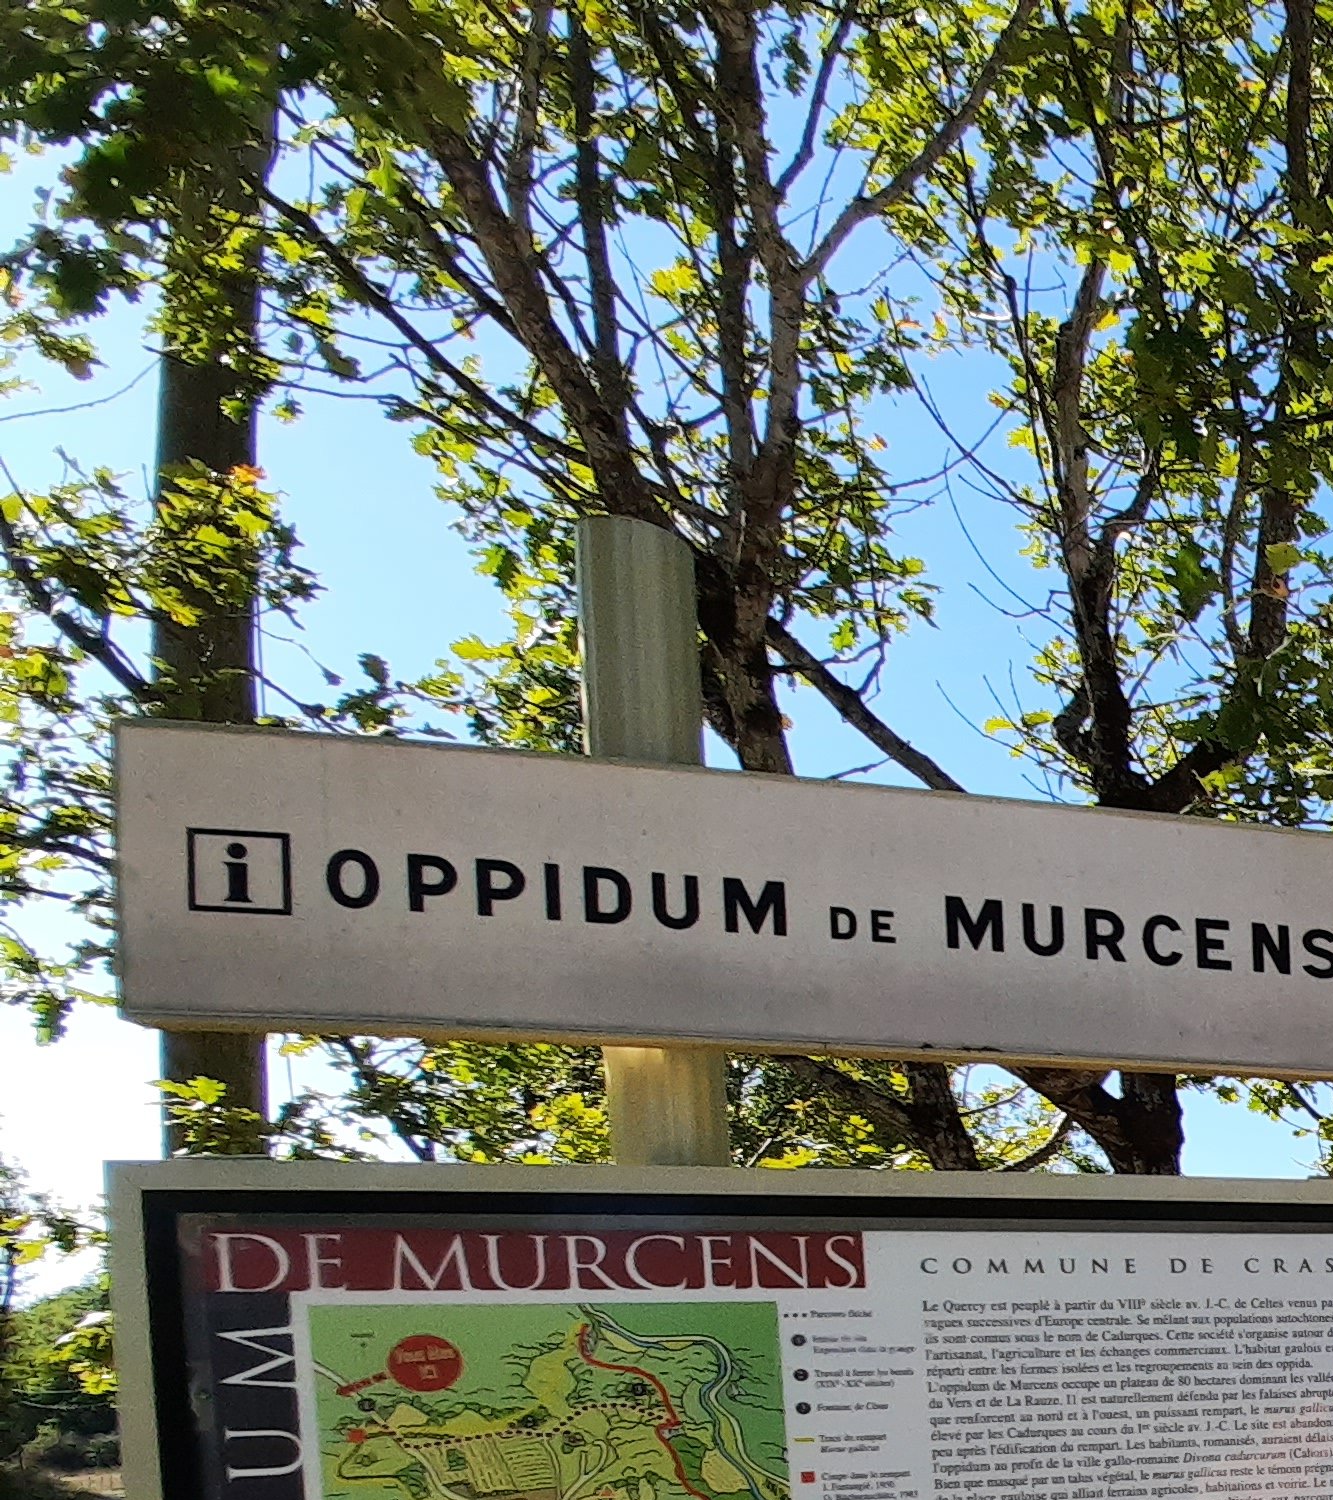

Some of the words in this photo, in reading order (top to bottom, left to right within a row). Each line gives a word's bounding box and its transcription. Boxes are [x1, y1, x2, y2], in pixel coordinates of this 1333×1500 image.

[326, 849, 788, 937] OPPIDUM
[829, 906, 897, 943] DE
[208, 1233, 346, 1292] DE
[393, 1234, 859, 1291] MURCENS
[920, 1257, 1136, 1274] COMMUNE
[1170, 1258, 1213, 1274] DE
[921, 1300, 938, 1311] Le
[942, 1300, 985, 1313] Quercy
[990, 1300, 1006, 1310] est
[1011, 1299, 1050, 1313] peuplé
[1054, 1299, 1060, 1310] à
[1064, 1299, 1096, 1312] partir
[1100, 1299, 1113, 1309] du
[1150, 1298, 1181, 1309] siècle
[1234, 1298, 1246, 1308] de
[1250, 1298, 1283, 1308] Celtes
[991, 1347, 1060, 1361] l'agriculture
[1065, 1347, 1075, 1357] et
[1080, 1346, 1095, 1357] les
[1099, 1345, 1150, 1359] échanges
[1234, 1343, 1280, 1354] L'habitat
[1284, 1342, 1321, 1355] gaulois
[926, 1380, 989, 1395] L'oppidum
[992, 1380, 1006, 1390] de
[1010, 1378, 1057, 1390] Murcens
[1061, 1380, 1100, 1391] occupe
[1103, 1380, 1117, 1388] un
[1120, 1376, 1158, 1390] plateau
[1161, 1376, 1174, 1386] de
[1178, 1375, 1191, 1386] 80
[1194, 1374, 1236, 1385] hectares
[1239, 1373, 1286, 1384] dominant
[1290, 1373, 1303, 1383] les
[927, 1397, 943, 1408] du
[947, 1396, 971, 1408] Vers
[975, 1396, 985, 1407] et
[989, 1396, 1002, 1406] de
[1006, 1395, 1021, 1406] La
[1066, 1394, 1076, 1404] Il
[1081, 1393, 1096, 1404] est
[1176, 1390, 1218, 1401] défendu
[1222, 1392, 1238, 1402] par
[1241, 1389, 1255, 1399] les
[1259, 1388, 1296, 1399] falaises
[928, 1416, 951, 1427] que
[1019, 1414, 1032, 1422] au
[1037, 1410, 1063, 1421] nord
[1067, 1409, 1077, 1420] et
[1082, 1409, 1088, 1420] à
[1092, 1408, 1131, 1421] l'ouest,
[1136, 1410, 1149, 1418] un
[1153, 1406, 1198, 1420] puissant
[1201, 1404, 1248, 1418] rempart,
[1072, 1487, 1103, 1499] alliait
[1107, 1485, 1147, 1497] terrains
[1205, 1480, 1262, 1492] habitations
[1265, 1479, 1274, 1489] et
[1313, 1477, 1326, 1487] Le
